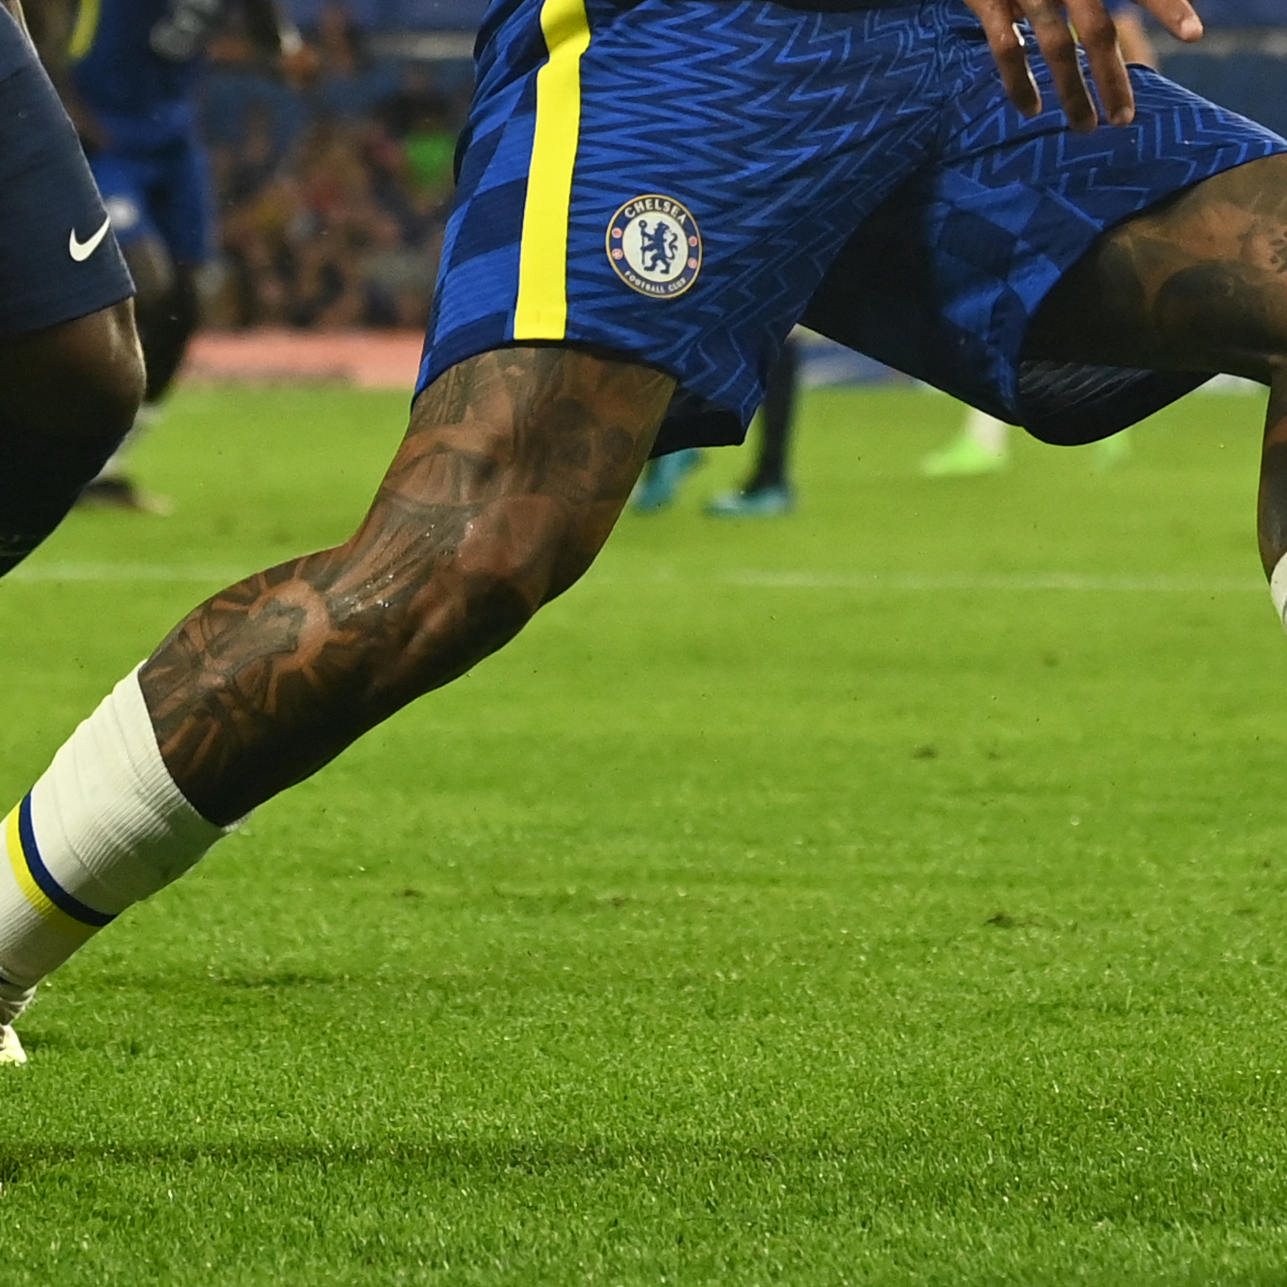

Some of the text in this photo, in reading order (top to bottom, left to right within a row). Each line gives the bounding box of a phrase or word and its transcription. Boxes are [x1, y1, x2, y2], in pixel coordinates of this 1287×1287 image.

[624, 199, 686, 225] CHELSEA
[624, 270, 687, 292] FOOTBALL CLUB
